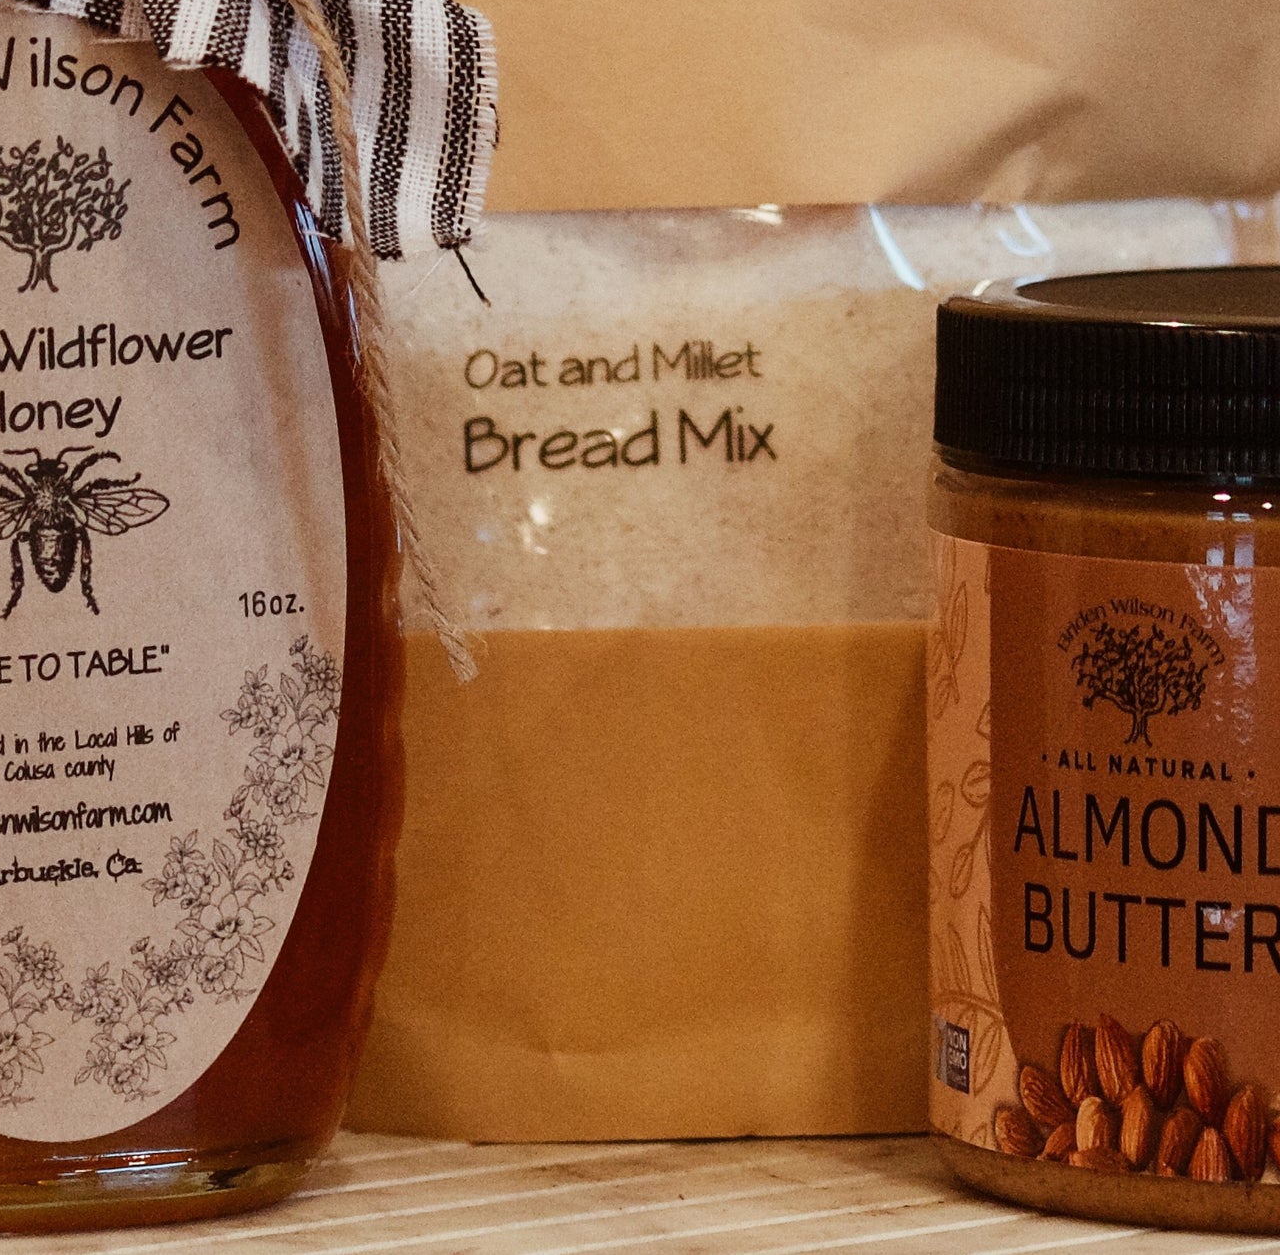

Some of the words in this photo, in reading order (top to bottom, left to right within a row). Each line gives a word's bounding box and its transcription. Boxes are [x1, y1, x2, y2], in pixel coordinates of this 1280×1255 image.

[149, 95, 241, 250] Farm
[464, 349, 547, 389] Oat
[558, 345, 640, 387] and
[652, 340, 762, 381] Millet
[464, 409, 659, 473] Bread
[678, 405, 777, 464] Mix
[1110, 597, 1175, 623] Wilson
[1179, 613, 1225, 666] Farm
[17, 653, 61, 681] TO
[15, 734, 29, 754] in
[37, 732, 66, 752] the
[75, 727, 117, 750] Local
[163, 721, 180, 743] of
[4, 760, 55, 782] Colusa
[65, 754, 115, 781] county
[1058, 749, 1096, 772] ALL
[1109, 755, 1233, 782] NATURAL
